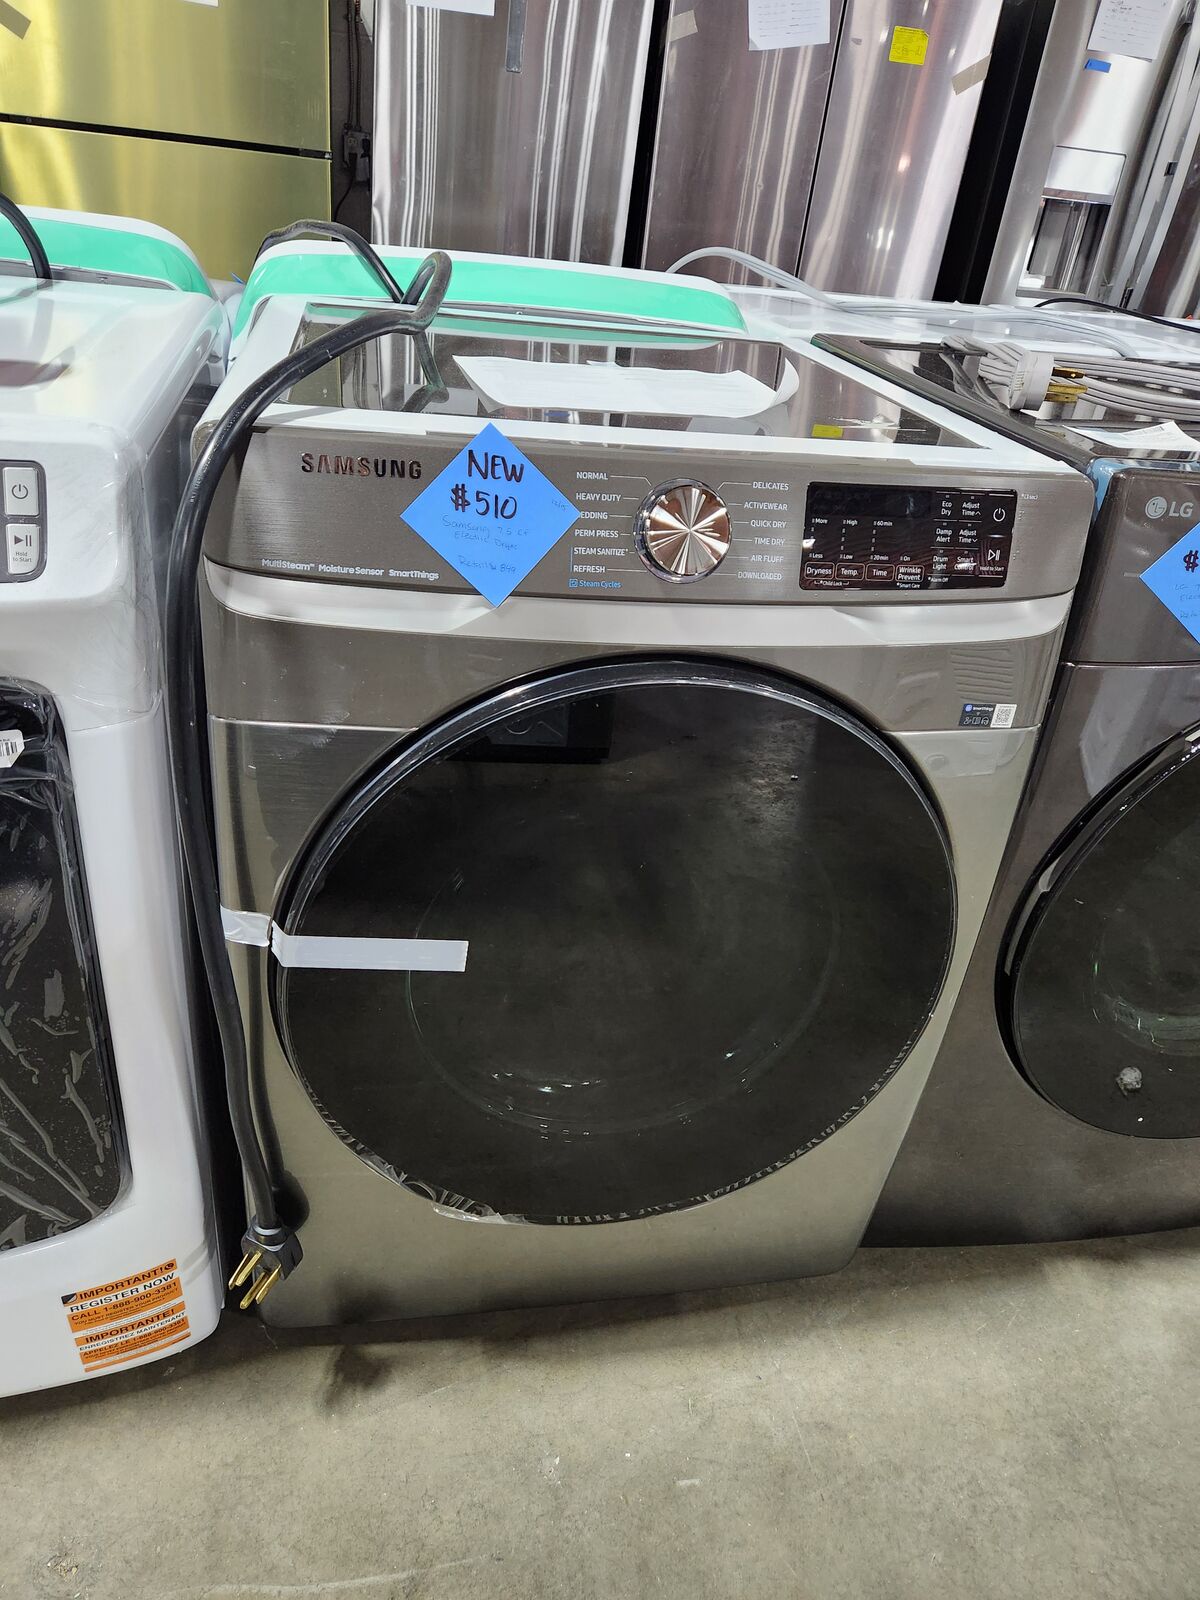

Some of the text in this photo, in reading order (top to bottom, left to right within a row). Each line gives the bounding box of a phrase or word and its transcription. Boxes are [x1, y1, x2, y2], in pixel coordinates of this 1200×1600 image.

[301, 452, 422, 480] SAMSUNG
[467, 449, 525, 483] NEW
[576, 472, 608, 480] NORMAL
[752, 482, 790, 490] DELICATES
[450, 483, 518, 520] $510
[576, 492, 621, 502] HEAVY DUTY
[744, 502, 788, 510] ACTIVEWEAR
[962, 502, 980, 510] Adjust
[1168, 502, 1194, 518] LG
[580, 511, 608, 520] EDDING
[442, 514, 490, 538] Samsung
[750, 520, 786, 528] QUICK DRY
[574, 528, 619, 538] PERM PRESS
[936, 528, 952, 536] Damp
[754, 537, 785, 546] TIME DRY
[574, 547, 598, 555] STEAM
[318, 564, 354, 574] Moisture
[355, 566, 385, 576] Sensor
[388, 568, 440, 581] SmartThings
[573, 564, 606, 573] REFRESH
[806, 566, 832, 576] Dryness
[841, 568, 858, 576] Temp.
[872, 568, 888, 576] Time
[738, 572, 782, 580] DOWNLOADED
[579, 580, 621, 588] Steam Cycles
[80, 1266, 164, 1300] IMPORTANT!
[70, 1287, 140, 1312] REGISTER
[144, 1272, 174, 1291] NOW
[72, 1310, 101, 1320] CALL
[104, 1282, 177, 1312] 1-888-900-3381
[80, 1332, 135, 1351] ENREGISTREZ
[136, 1312, 185, 1334] MAINTENANT
